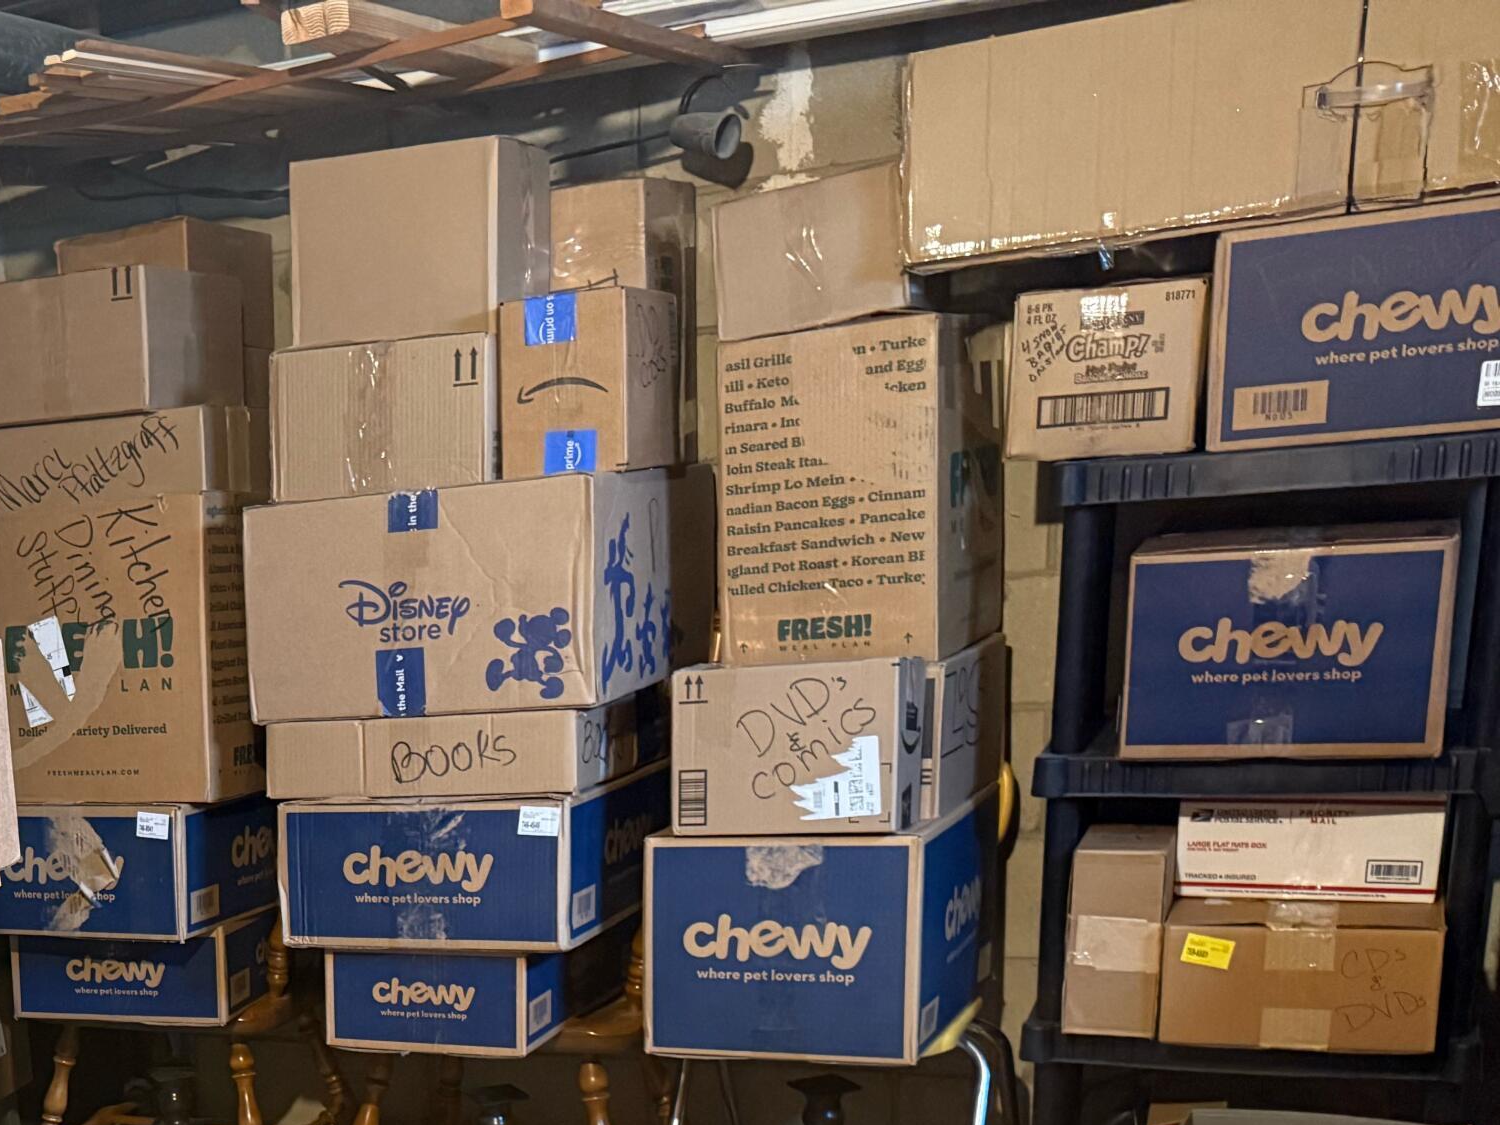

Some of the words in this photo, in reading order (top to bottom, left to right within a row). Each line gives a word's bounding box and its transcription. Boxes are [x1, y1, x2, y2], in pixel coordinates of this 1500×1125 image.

[1301, 283, 1500, 343] chewy
[1315, 349, 1366, 366] where
[1369, 347, 1398, 364] pet
[1402, 343, 1453, 357] lovers
[1457, 338, 1499, 353] shop
[756, 375, 790, 389] Keto
[865, 360, 893, 375] and
[724, 397, 776, 414] Buffalo
[562, 440, 574, 471] prime
[740, 437, 788, 453] Seared
[755, 457, 795, 472] Steak
[726, 481, 780, 497] Shrimp
[784, 477, 803, 490] Lo
[806, 474, 844, 488] Mein
[726, 501, 772, 516] nadian
[775, 497, 819, 513] Bacon
[822, 494, 856, 509] Eggs
[726, 522, 771, 537] Raisin
[774, 516, 845, 533] Pancakes
[860, 509, 926, 525] Pancake
[726, 541, 797, 557] Breakfast
[800, 533, 875, 551] Sandwich
[890, 530, 925, 544] New
[97, 503, 173, 633] Kitchen
[772, 560, 796, 574] Pot
[798, 557, 838, 571] Roast
[851, 552, 905, 567] Korean
[54, 514, 120, 636] Dining
[727, 582, 765, 596] ulled
[767, 578, 826, 593] Chicken
[829, 576, 864, 589] Taco
[379, 621, 442, 643] store
[777, 614, 872, 642] FRESH!
[1178, 617, 1385, 667] chewy
[120, 677, 173, 693] LAN
[394, 668, 405, 692] Mail
[1190, 669, 1239, 684] where
[1241, 670, 1269, 685] pet
[1272, 668, 1321, 683] lovers
[1322, 667, 1362, 684] shop
[395, 694, 406, 711] the
[73, 725, 110, 739] ariety
[112, 723, 167, 737] Delivered
[391, 729, 517, 784] BOOKS
[342, 845, 494, 893] chewy
[13, 889, 42, 900] where
[43, 891, 59, 902] pet
[354, 893, 389, 904] where
[392, 894, 412, 907] pet
[413, 892, 450, 905] lovers
[452, 892, 481, 907] shop
[683, 913, 873, 970] chewy
[65, 954, 166, 988] chewy
[696, 967, 741, 982] where
[743, 970, 769, 984] pet
[771, 969, 816, 983] lovers
[819, 970, 855, 986] shop
[74, 986, 98, 995] where
[99, 987, 114, 997] pet
[115, 986, 138, 996] lovers
[139, 987, 160, 998] shop
[372, 977, 476, 1012] chewy
[380, 1008, 404, 1018] where
[406, 1009, 420, 1020] pet
[421, 1010, 446, 1019] lovers
[447, 1011, 467, 1021] shop
